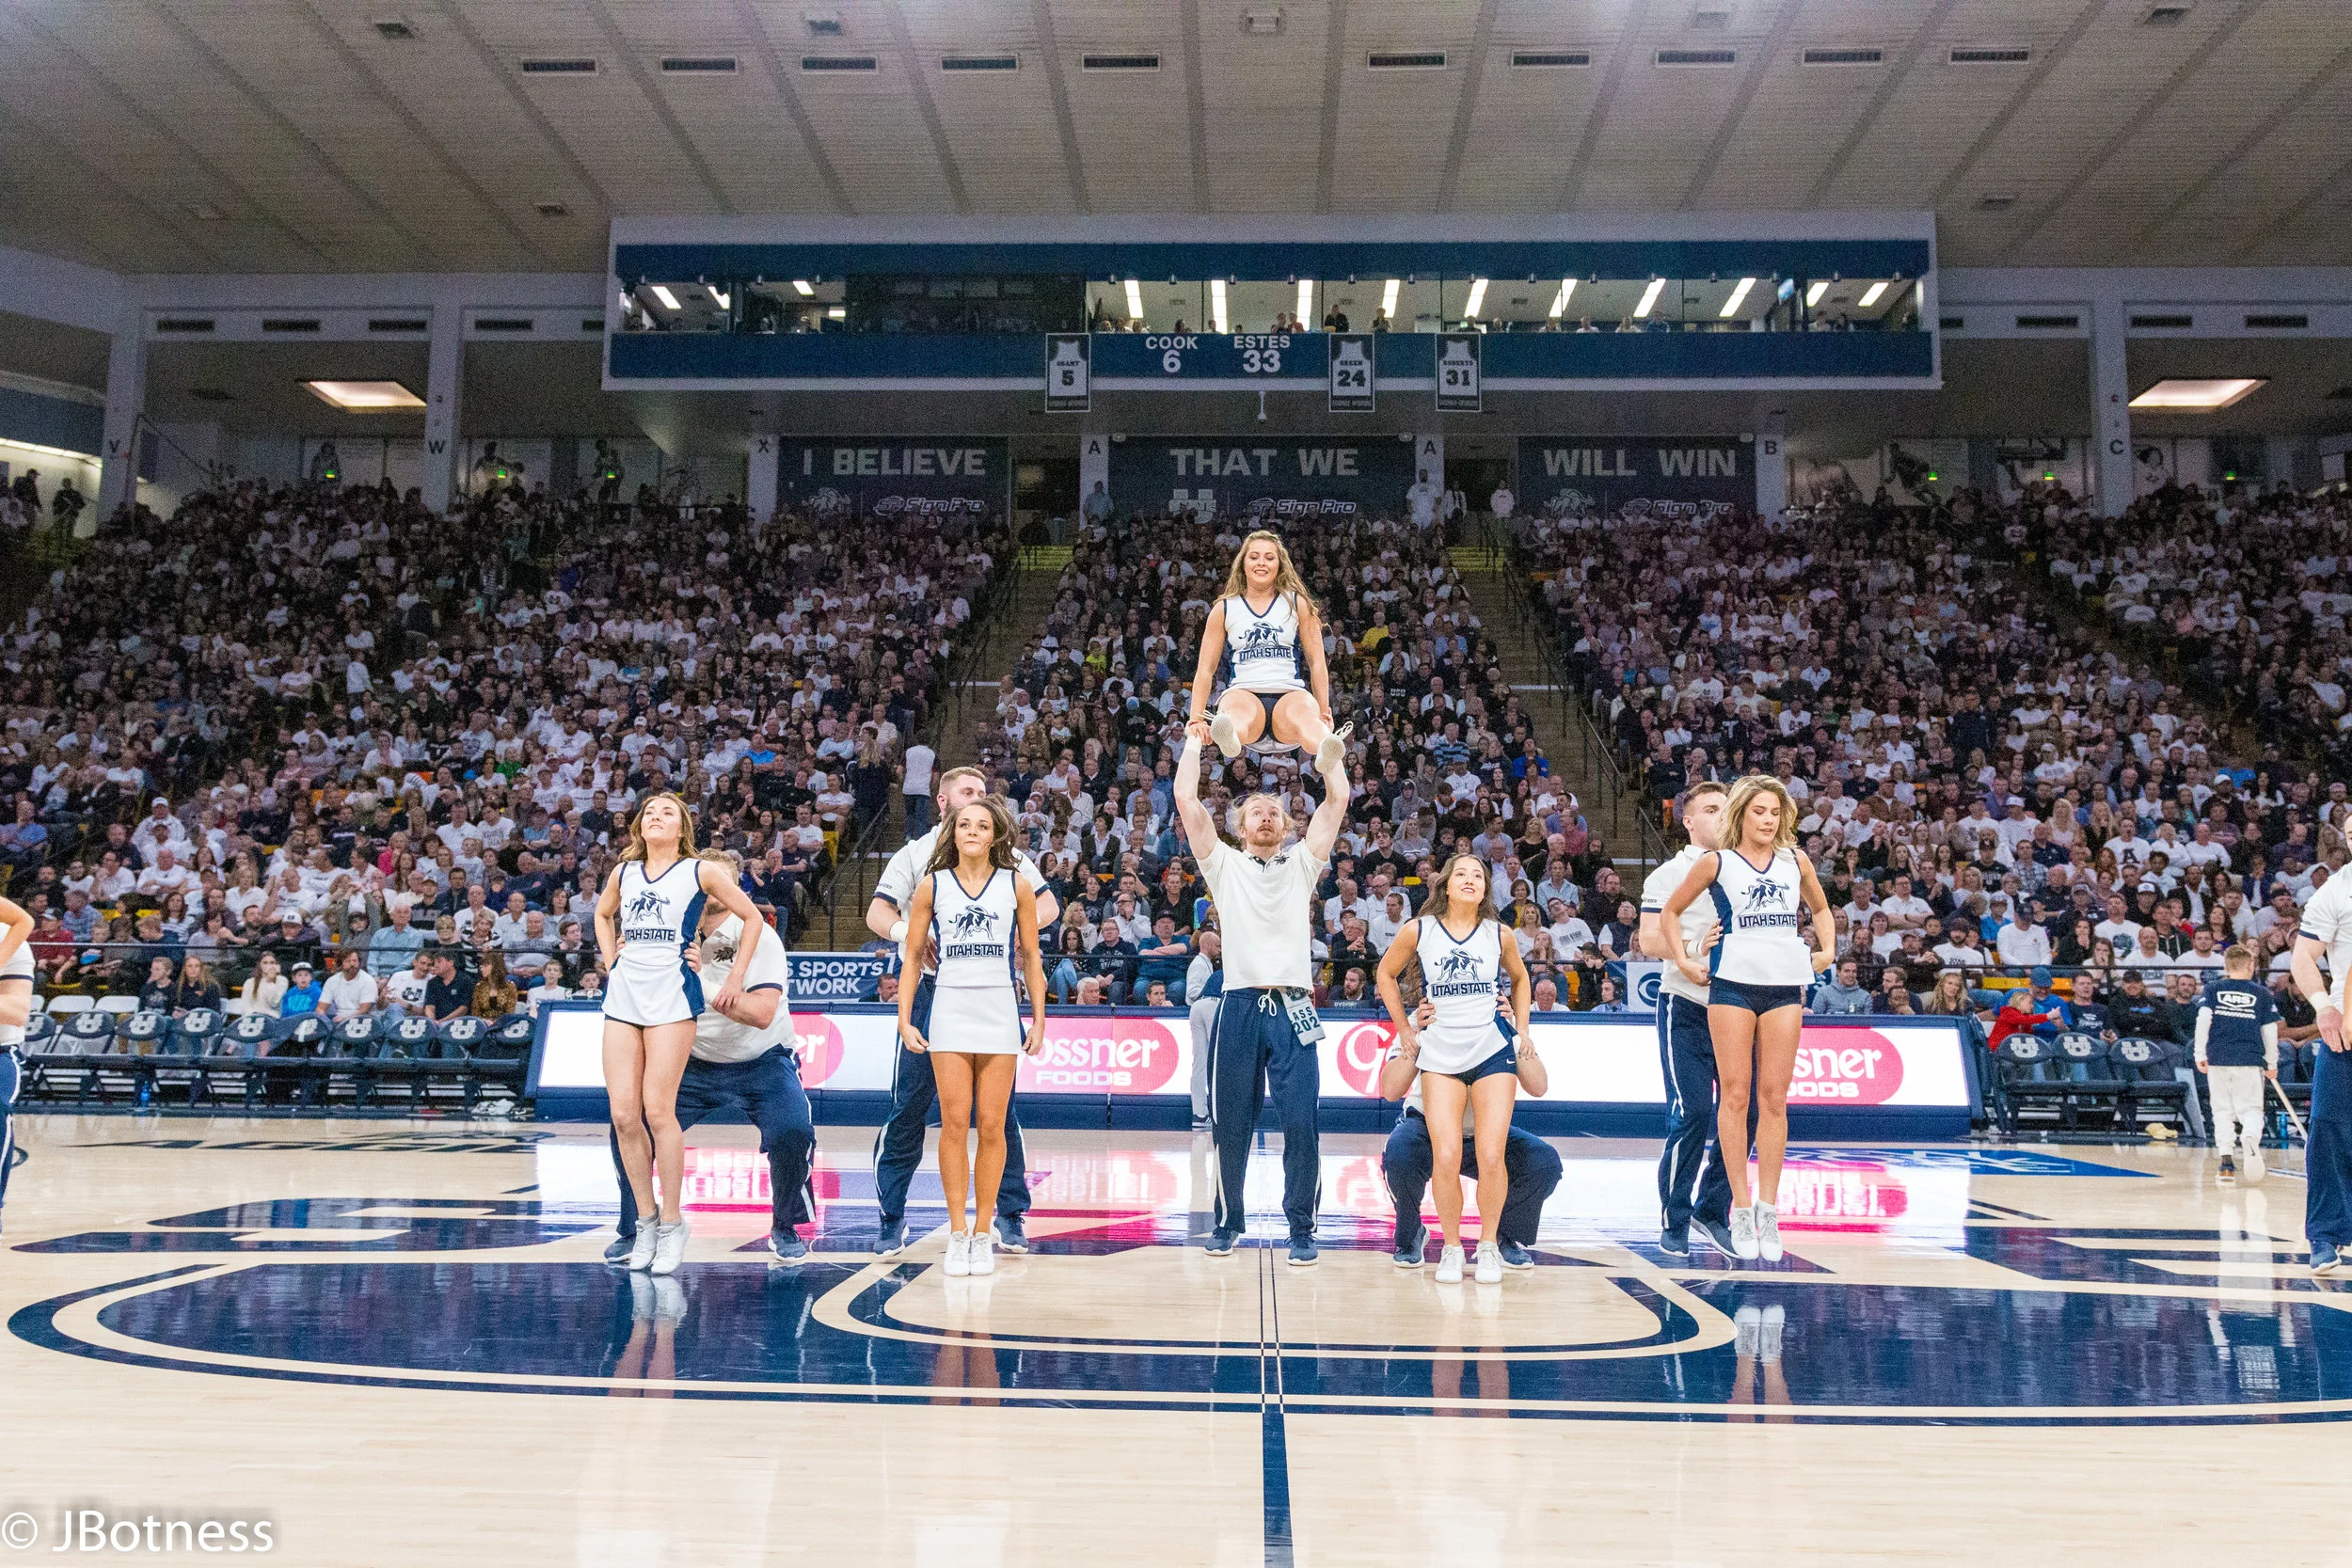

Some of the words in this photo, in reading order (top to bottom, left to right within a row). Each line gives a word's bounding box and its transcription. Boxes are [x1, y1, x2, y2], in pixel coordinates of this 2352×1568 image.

[1145, 336, 1199, 350] COOK
[1233, 335, 1291, 349] ESTES
[1162, 350, 1182, 372] 6
[1242, 350, 1281, 372] 33
[1061, 370, 1074, 387] 5
[1337, 370, 1366, 387] 24
[1445, 369, 1471, 387] 31
[428, 440, 446, 454] W
[757, 438, 771, 454] X
[1088, 439, 1102, 455] A
[1422, 439, 1438, 455] A
[1764, 439, 1778, 455] B
[2109, 439, 2124, 455] C
[803, 449, 813, 475] I
[833, 449, 987, 476] BELIEVE
[1169, 449, 1278, 476] THAT
[1297, 449, 1359, 476] WE
[1543, 449, 1638, 477] WILL
[1658, 449, 1737, 477] WIN
[1320, 499, 1357, 514] Pro
[1239, 649, 1263, 663] UTAH
[1264, 646, 1292, 659] STATE
[1740, 914, 1767, 928] UTAH
[1769, 913, 1797, 928] STATE
[643, 927, 675, 942] STATE
[946, 943, 973, 958] UTAH
[974, 942, 1005, 958] STATE
[798, 960, 884, 978] SPORTS
[1432, 983, 1459, 998] UTAH
[1460, 981, 1493, 996] STATE
[2222, 993, 2251, 1005] ARS
[1021, 1033, 1159, 1070] ossner
[1036, 1070, 1133, 1086] FOODS
